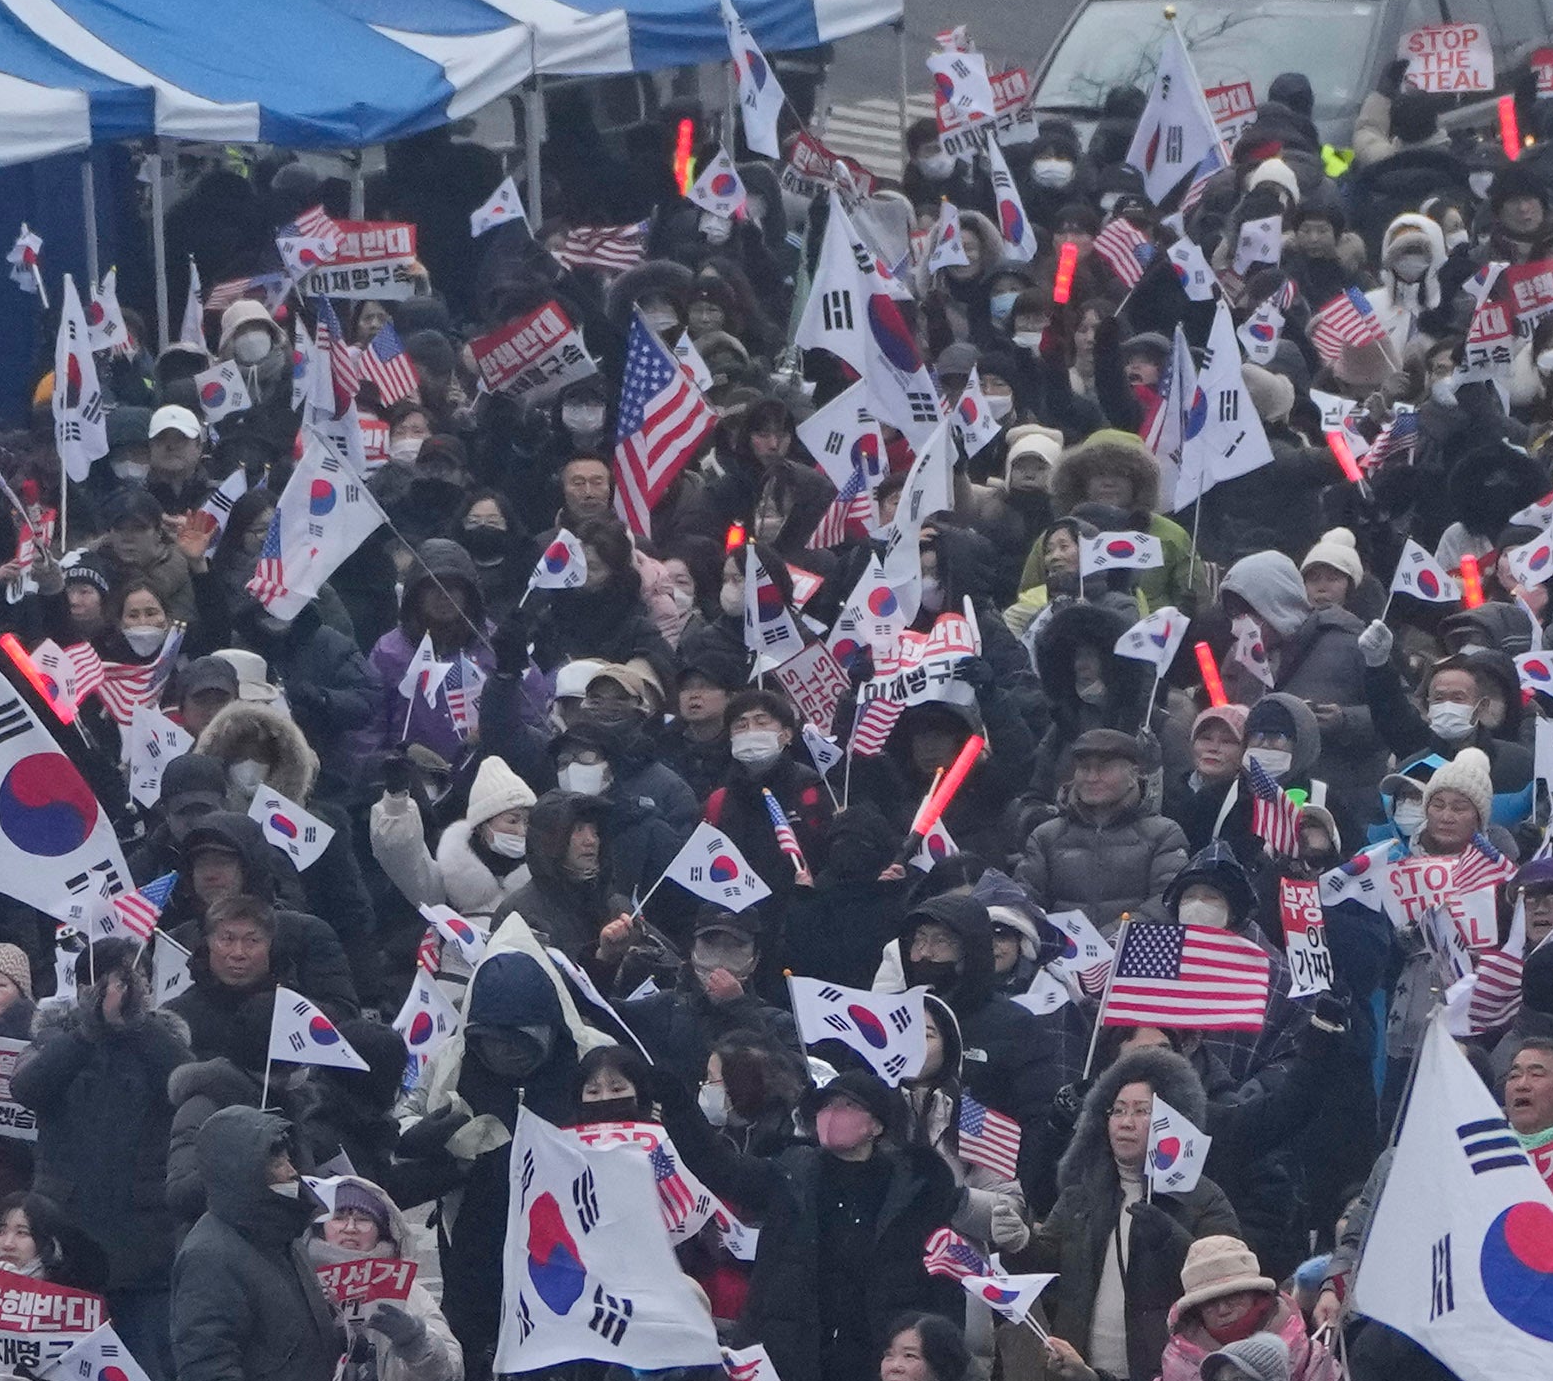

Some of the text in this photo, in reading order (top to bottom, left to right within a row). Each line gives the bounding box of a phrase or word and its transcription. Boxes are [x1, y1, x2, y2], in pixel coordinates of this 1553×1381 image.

[1408, 35, 1479, 54] STOP
[1423, 52, 1470, 71] THE
[339, 224, 413, 259] 핵반대
[472, 307, 570, 388] 탄핵반대
[1389, 865, 1449, 897] STO
[315, 1262, 416, 1301] 정선거
